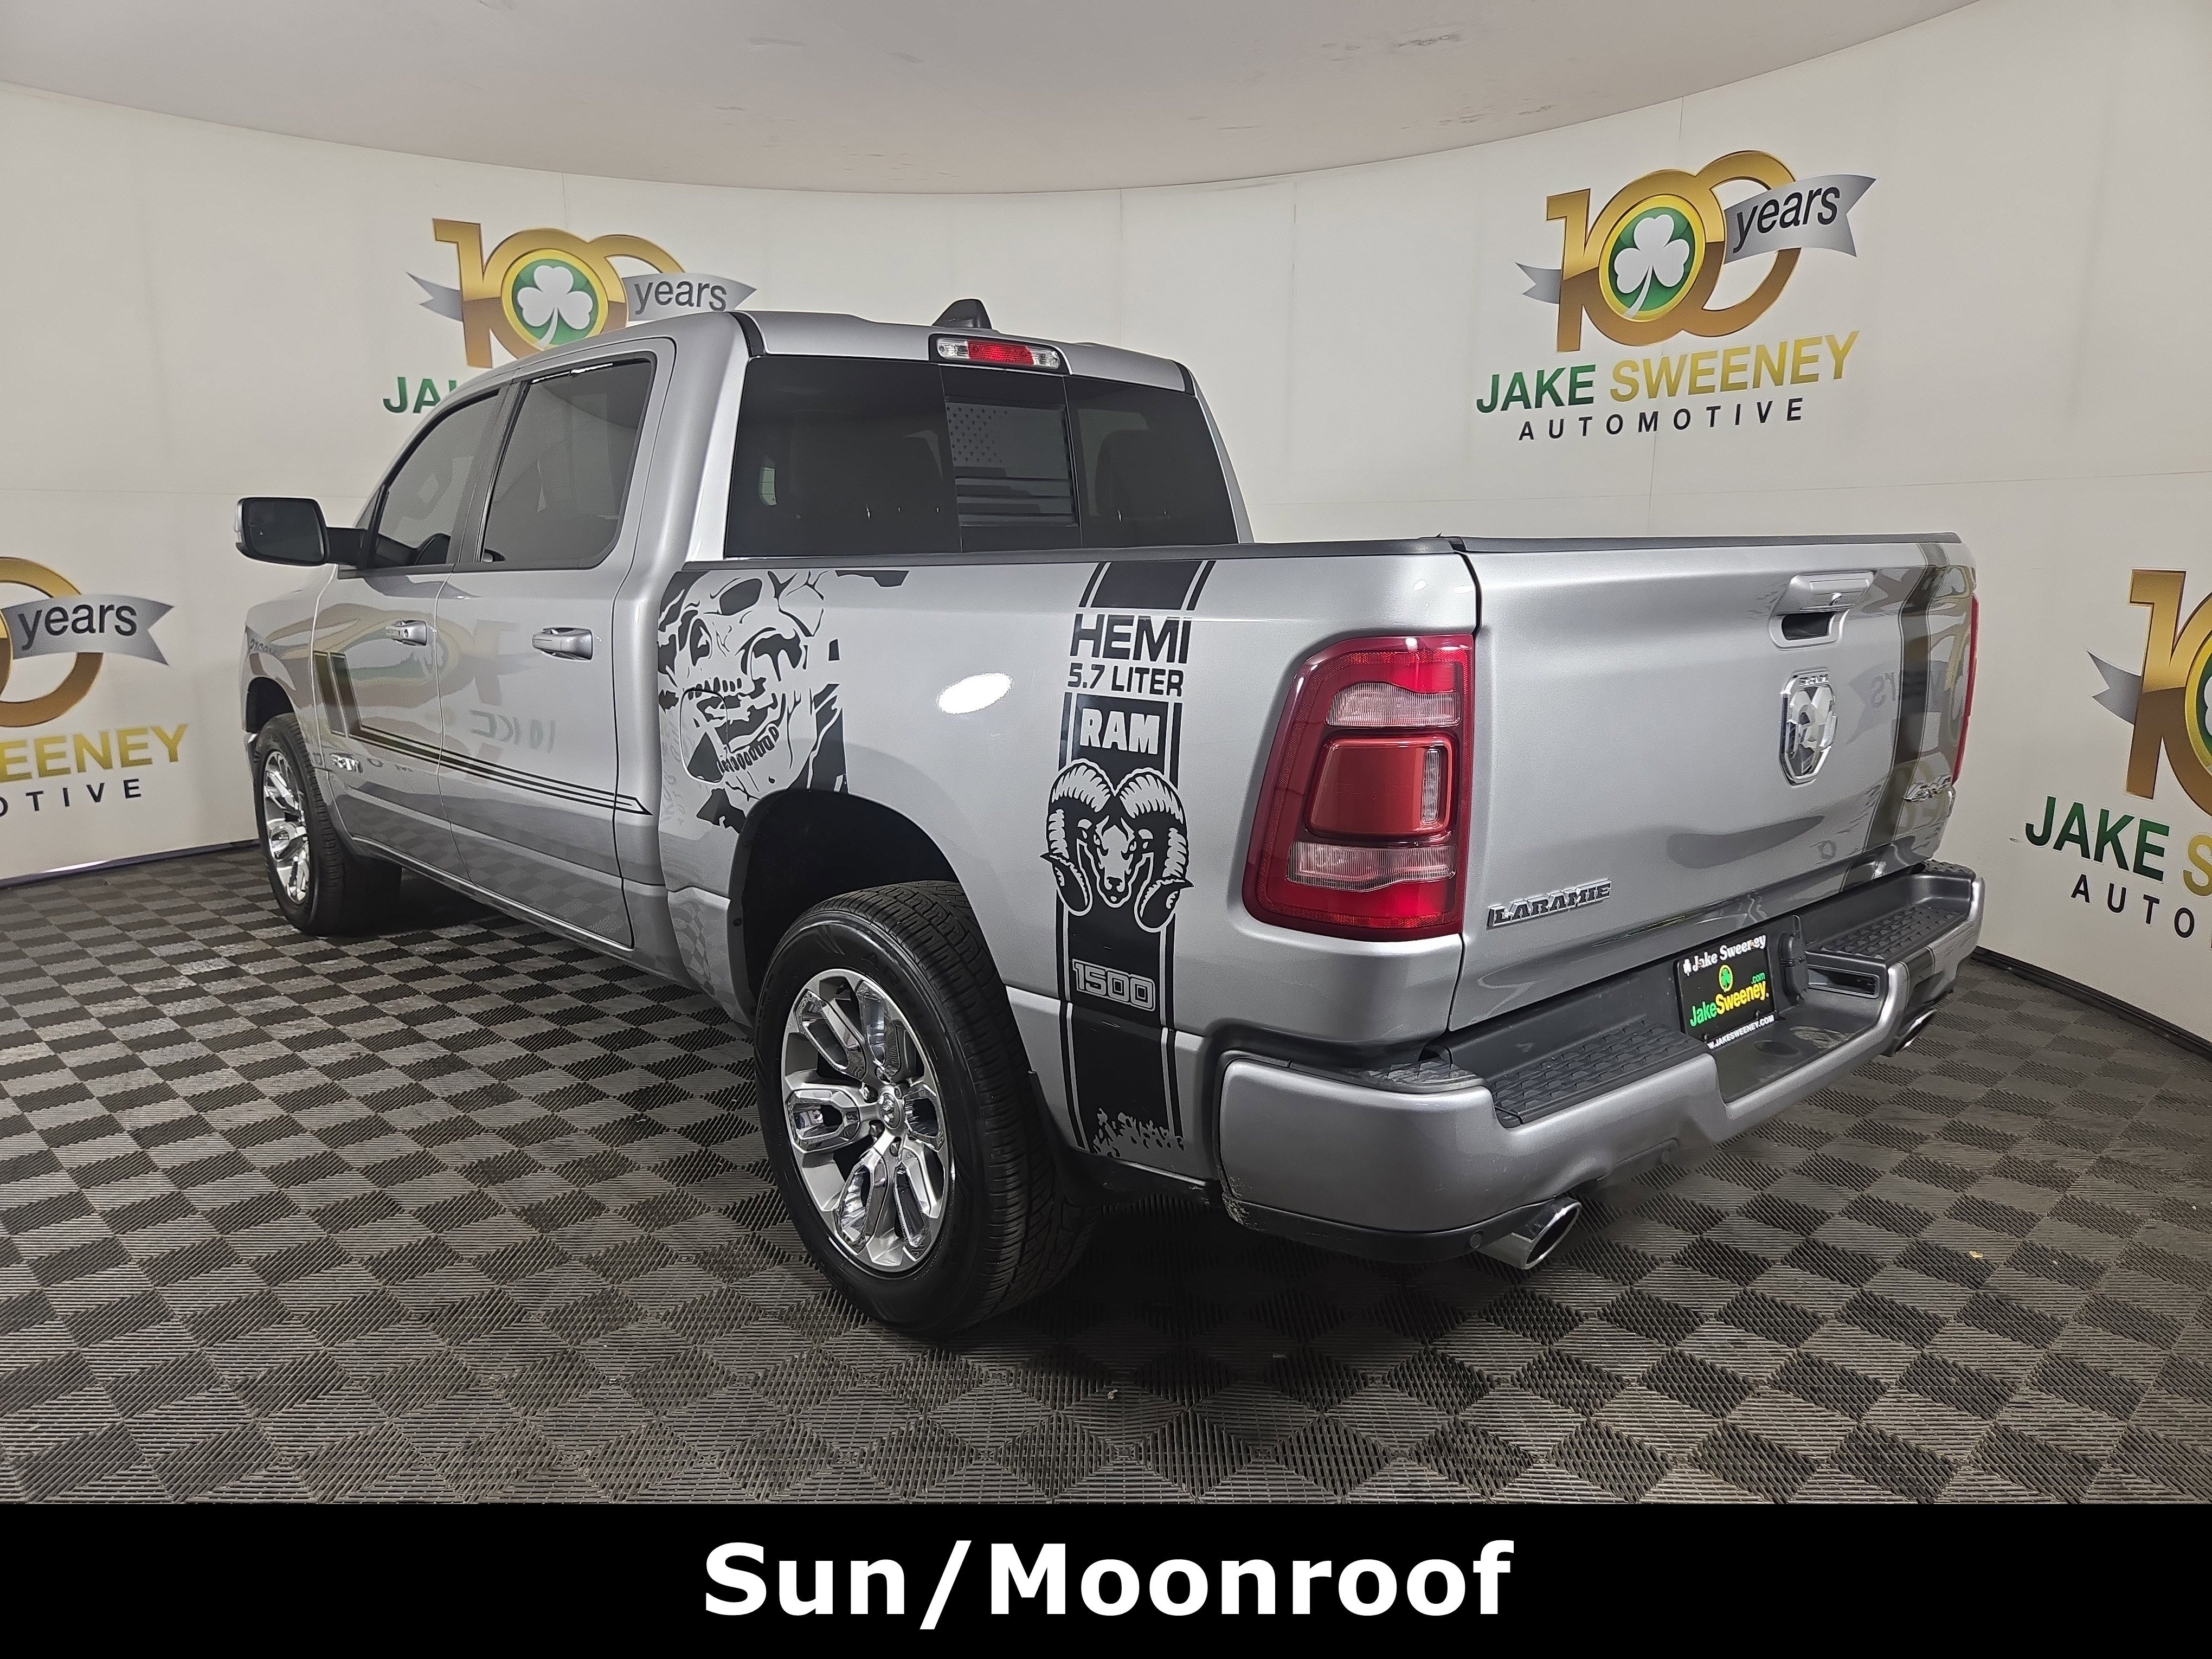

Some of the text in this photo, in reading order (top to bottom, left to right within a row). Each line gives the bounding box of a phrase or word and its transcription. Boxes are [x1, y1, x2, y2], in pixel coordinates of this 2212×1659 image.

[1732, 186, 1841, 255] years
[1546, 150, 1802, 352] 100
[634, 278, 728, 316] years
[383, 376, 456, 414] JA
[1475, 330, 1860, 413] JAKE SWEENEY
[1518, 397, 1803, 441] AUTOMOTIVE
[18, 603, 138, 651] years
[1070, 613, 1192, 664] HEMI
[1067, 662, 1184, 697] 5.7 LITER
[1079, 708, 1161, 755] RAM
[2025, 795, 2170, 882] JAKE
[1488, 879, 1612, 928] LARAMIE
[2070, 874, 2212, 949] AUTO
[1072, 958, 1156, 1012] 1500
[1692, 951, 1718, 972] Jake
[1751, 972, 1765, 984] .com
